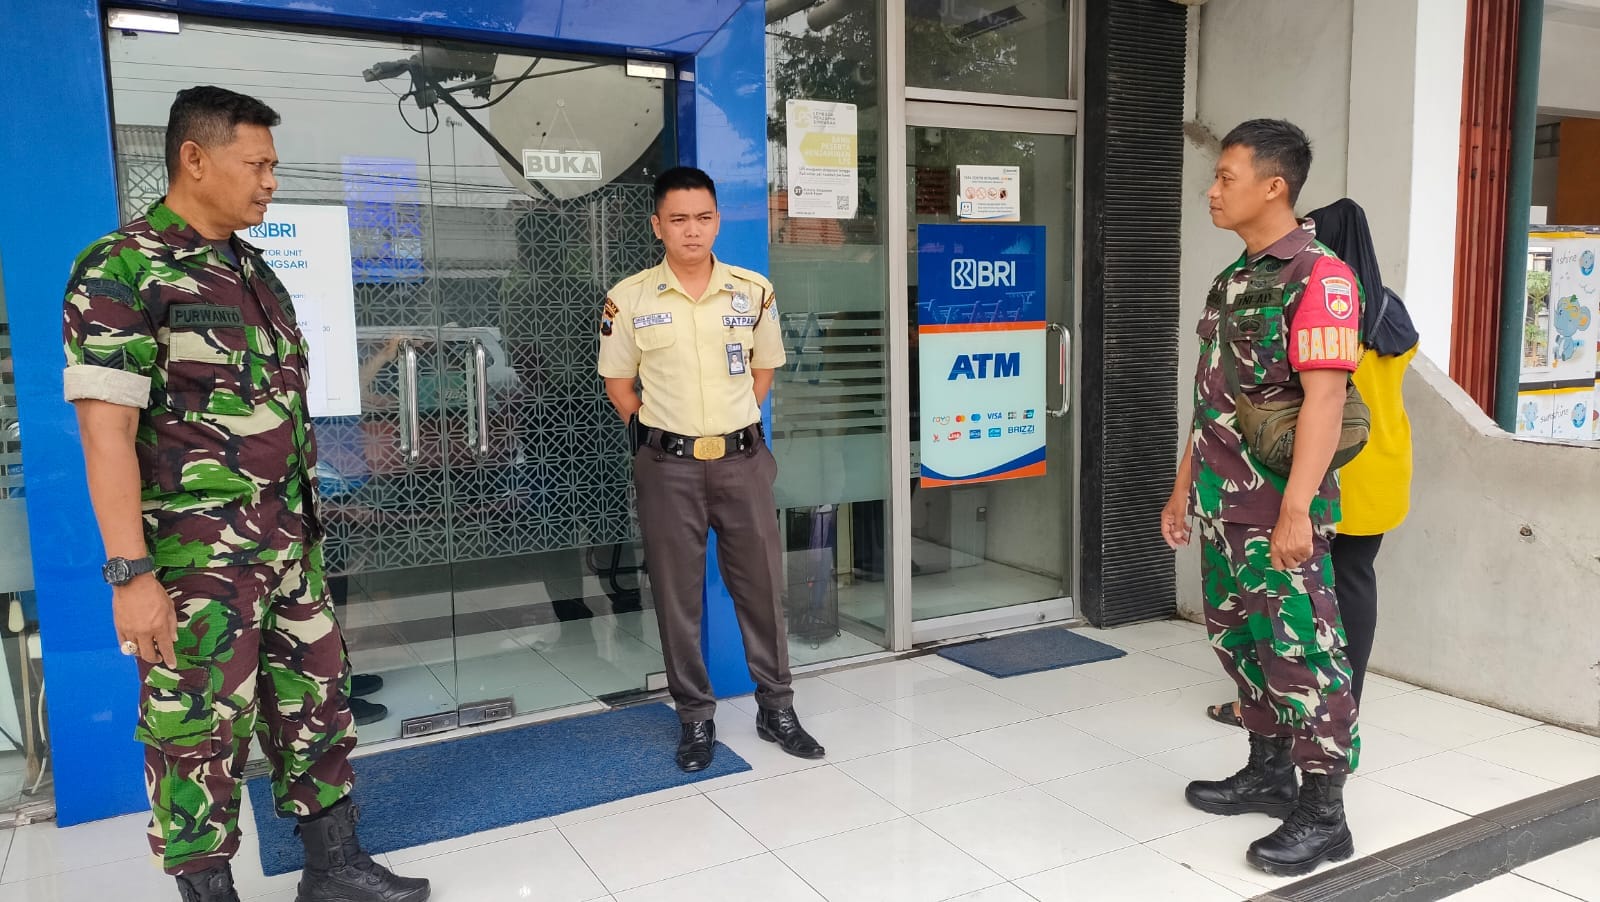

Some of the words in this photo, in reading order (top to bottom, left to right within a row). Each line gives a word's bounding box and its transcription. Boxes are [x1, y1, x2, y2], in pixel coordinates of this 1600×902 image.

[526, 155, 598, 174] BUKA
[268, 222, 296, 238] BRI
[284, 249, 302, 257] UNIT
[978, 260, 1016, 287] BRI
[174, 309, 241, 324] PURWANTO
[947, 352, 1020, 381] ATM
[987, 412, 1003, 420] VISA
[1007, 424, 1035, 434] BRIZZI
